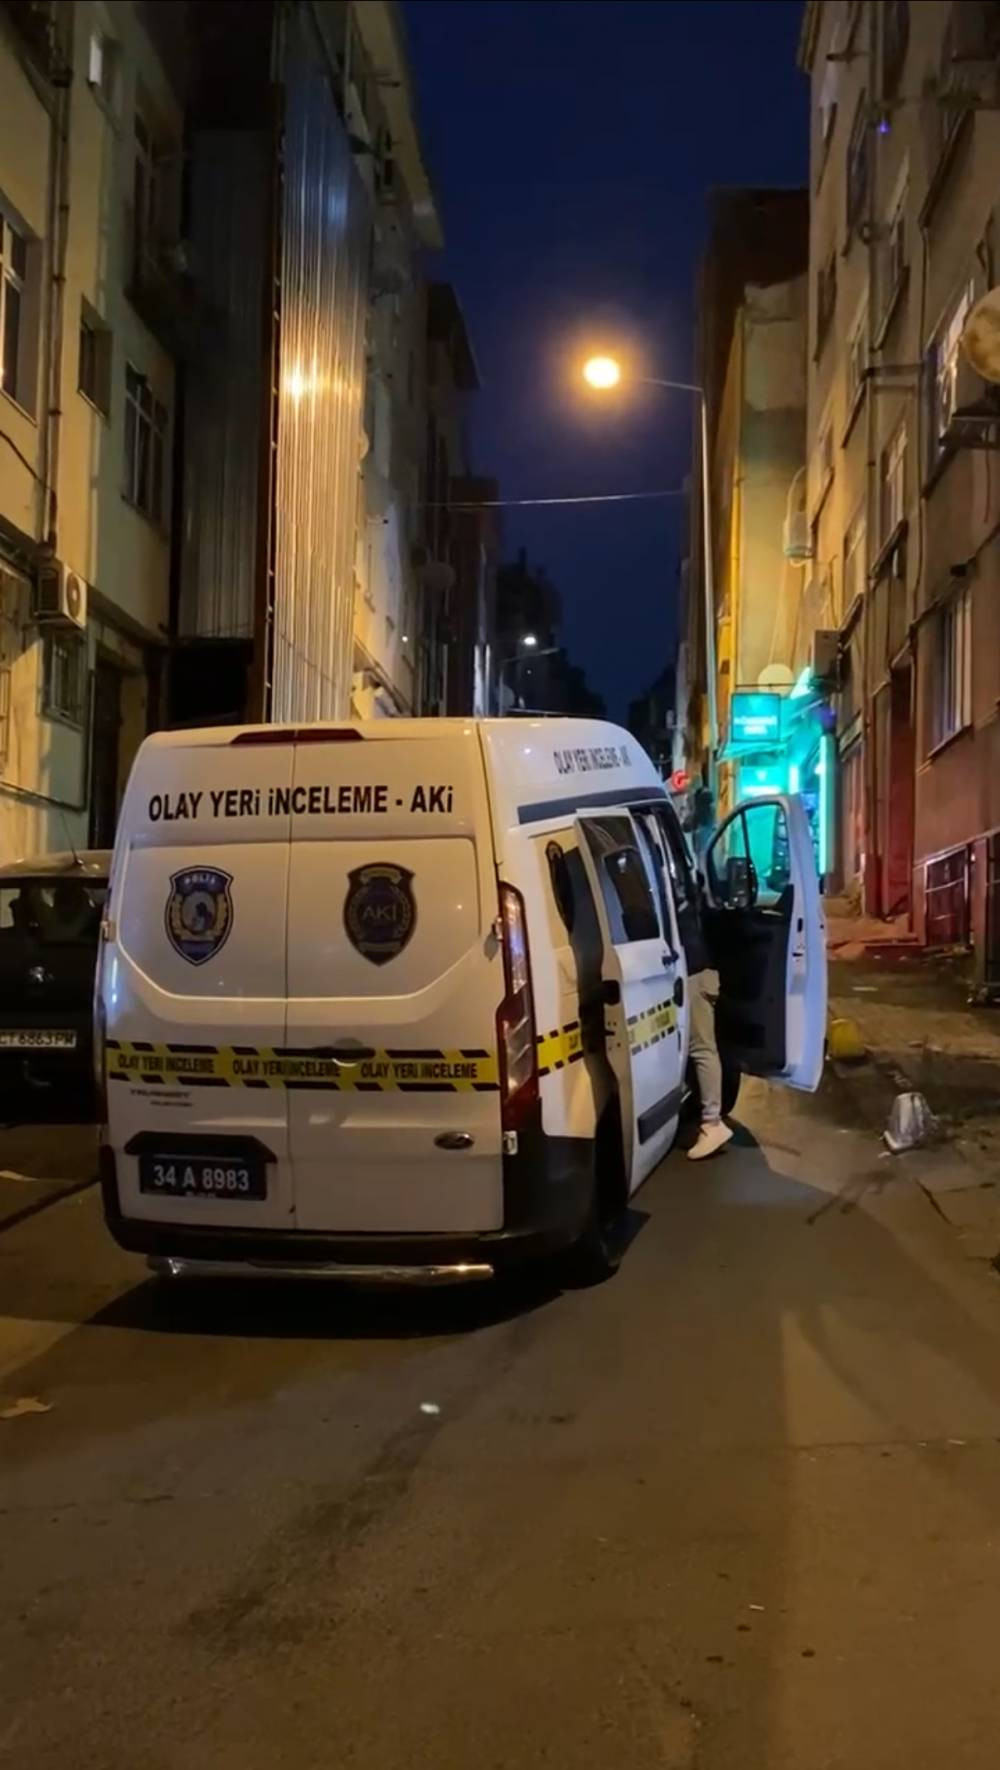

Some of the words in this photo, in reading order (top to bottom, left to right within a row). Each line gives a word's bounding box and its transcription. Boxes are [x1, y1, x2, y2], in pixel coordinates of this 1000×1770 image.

[149, 791, 203, 821] OLAY
[118, 1053, 139, 1070] OLAY
[233, 1059, 258, 1075] OLAY
[361, 1062, 389, 1078] OLAY
[153, 1164, 177, 1187] 34
[182, 1166, 195, 1188] A
[202, 1168, 250, 1191] 8983
